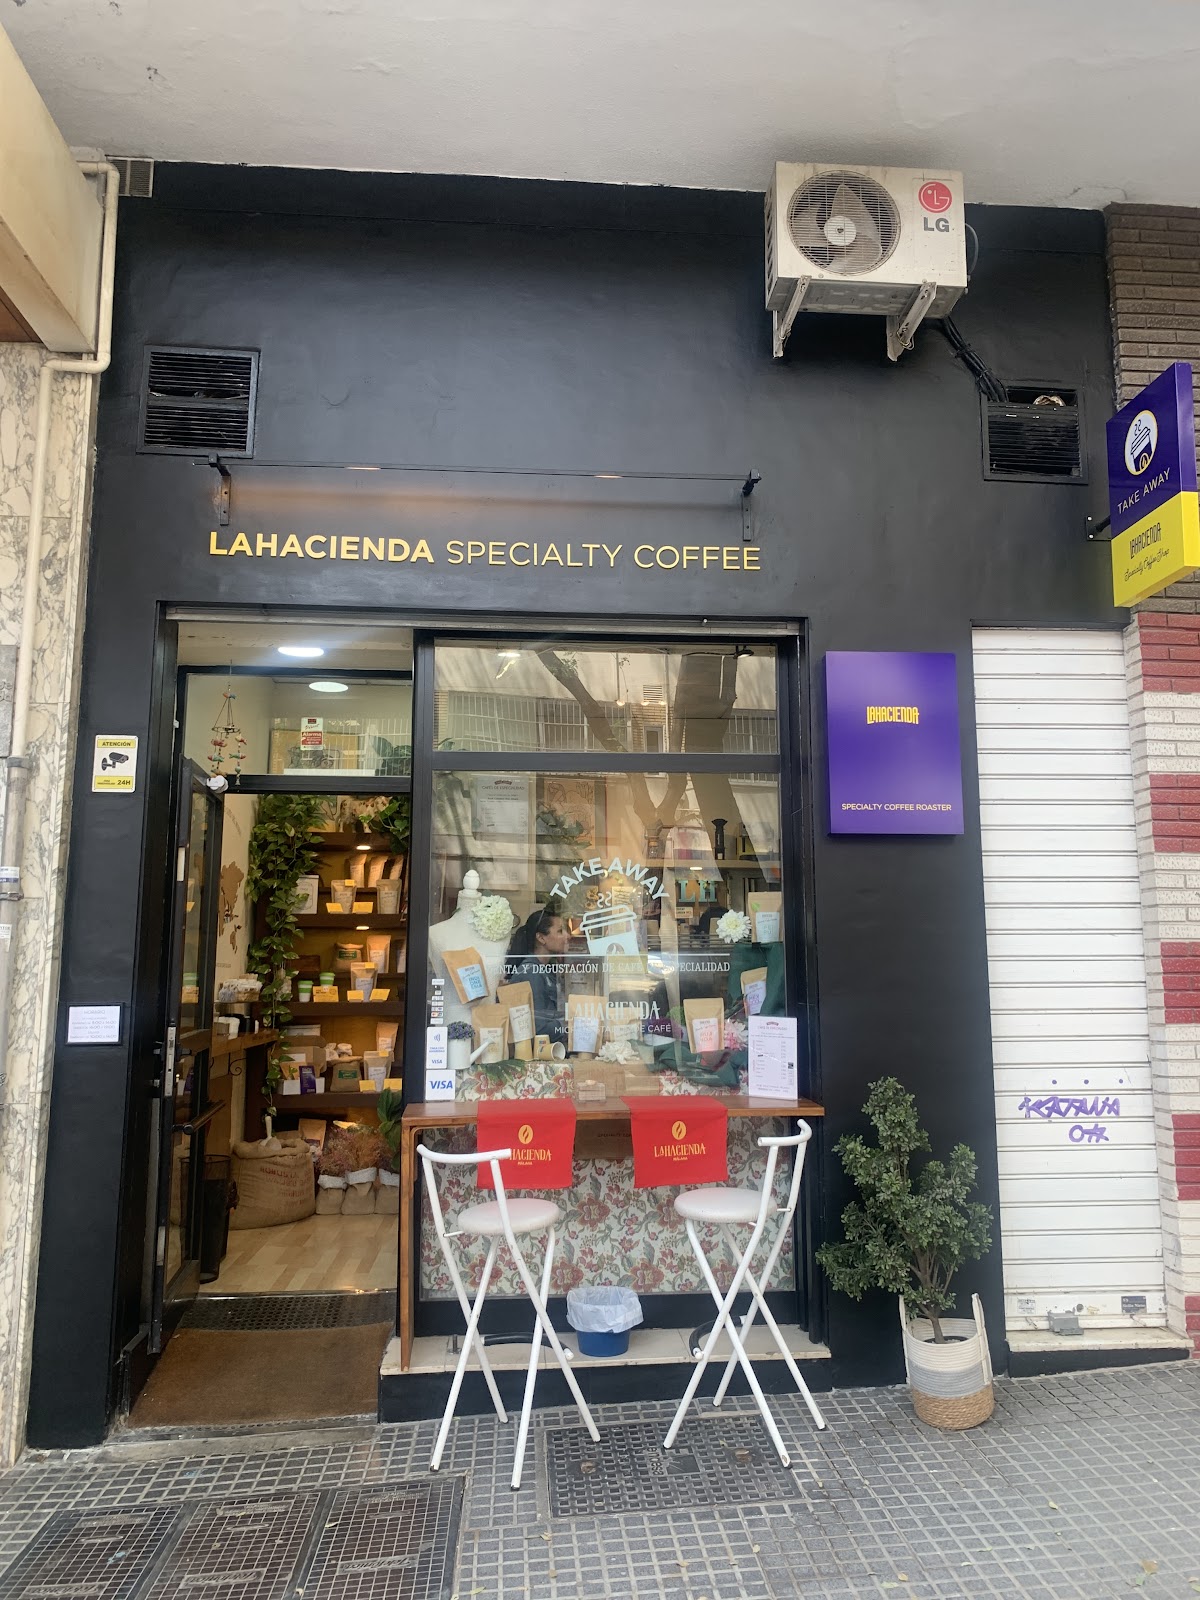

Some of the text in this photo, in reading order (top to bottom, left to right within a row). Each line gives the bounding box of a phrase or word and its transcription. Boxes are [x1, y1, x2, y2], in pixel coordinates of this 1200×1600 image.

[923, 217, 949, 232] LG
[1117, 467, 1170, 514] TAKE AWAY
[209, 531, 762, 570] LAHACIENDA SPECIALTY COFFEE
[866, 706, 920, 724] LAHACIENDA
[842, 803, 952, 811] SPECIALTY COFFEE ROASTER
[550, 857, 670, 900] TAKE AWAY
[677, 879, 718, 903] LH
[521, 964, 530, 974] Y
[532, 960, 599, 974] DEGUSTACIÓN
[602, 962, 614, 973] DE
[564, 1000, 661, 1022] LAHACIENDA
[647, 1024, 672, 1033] CAFÉ
[430, 1080, 453, 1090] VISA
[653, 1142, 706, 1158] LAHACIENDA
